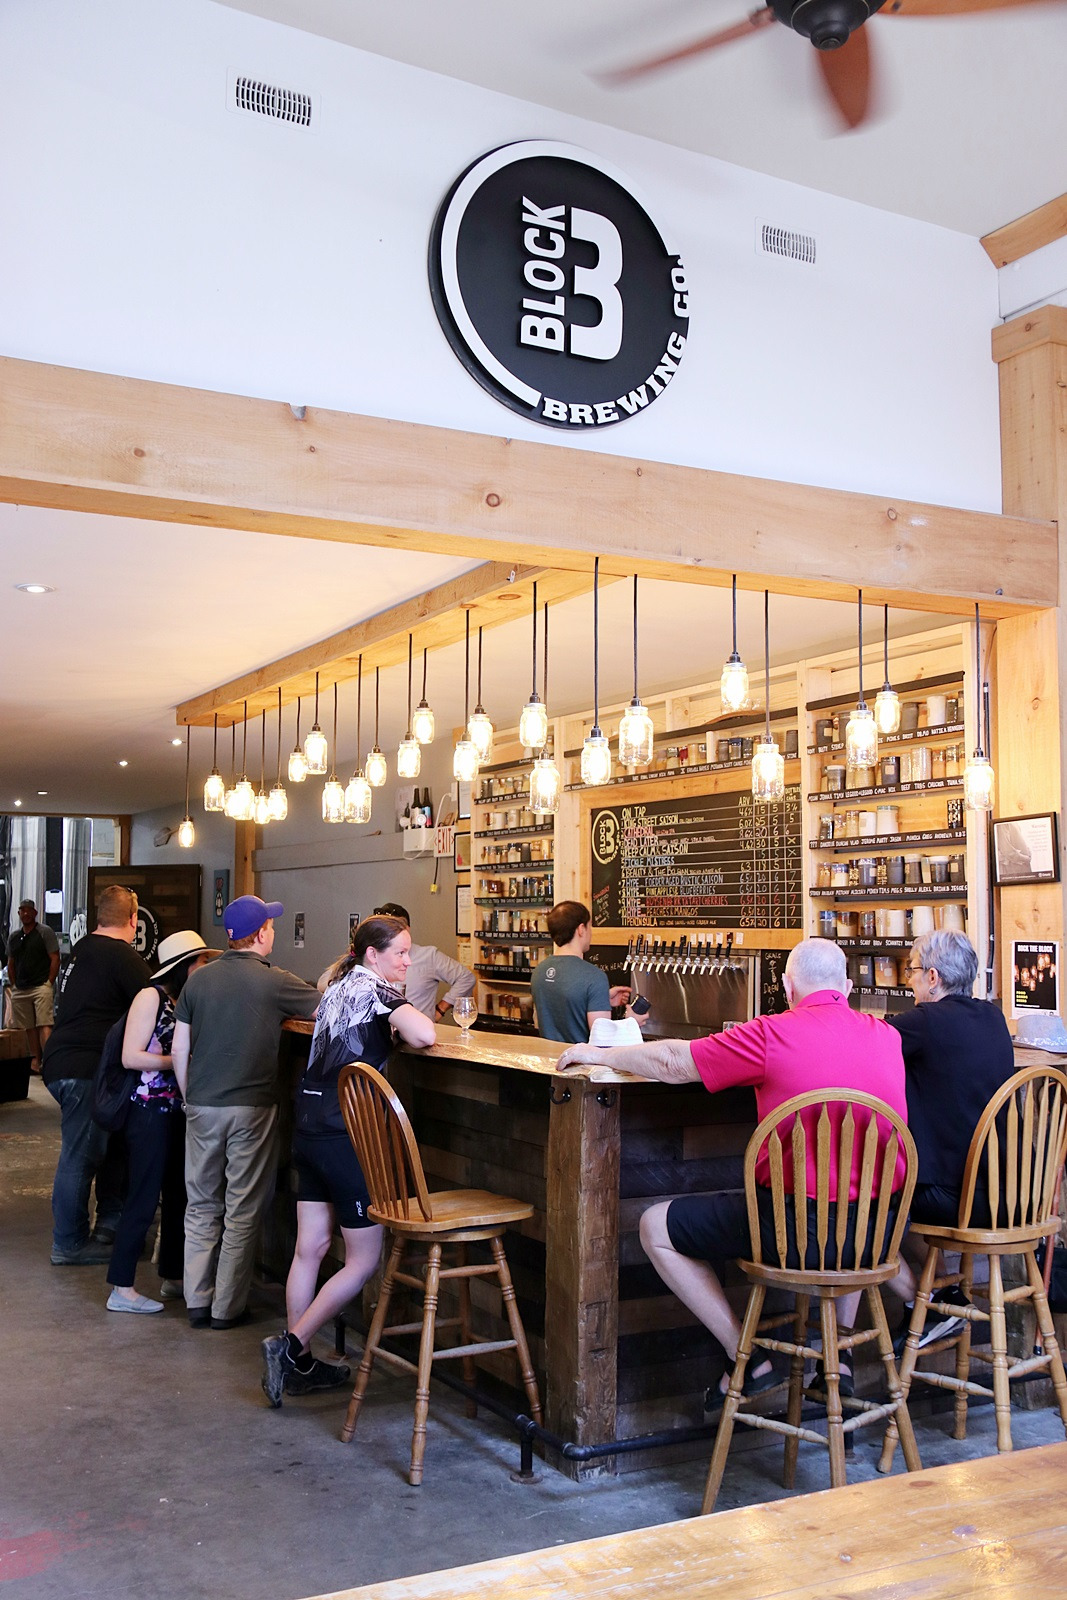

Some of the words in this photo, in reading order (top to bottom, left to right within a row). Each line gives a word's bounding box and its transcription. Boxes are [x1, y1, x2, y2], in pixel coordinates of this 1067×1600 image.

[521, 196, 565, 352] BLOCK
[570, 207, 623, 361] 3
[542, 331, 686, 425] BREWING
[621, 807, 632, 819] ON
[634, 806, 647, 817] TAP
[637, 817, 658, 827] STREET
[659, 814, 679, 826] SAISON
[437, 827, 452, 854] EXIT
[662, 843, 689, 855] SAISON
[701, 874, 724, 885] SAISON
